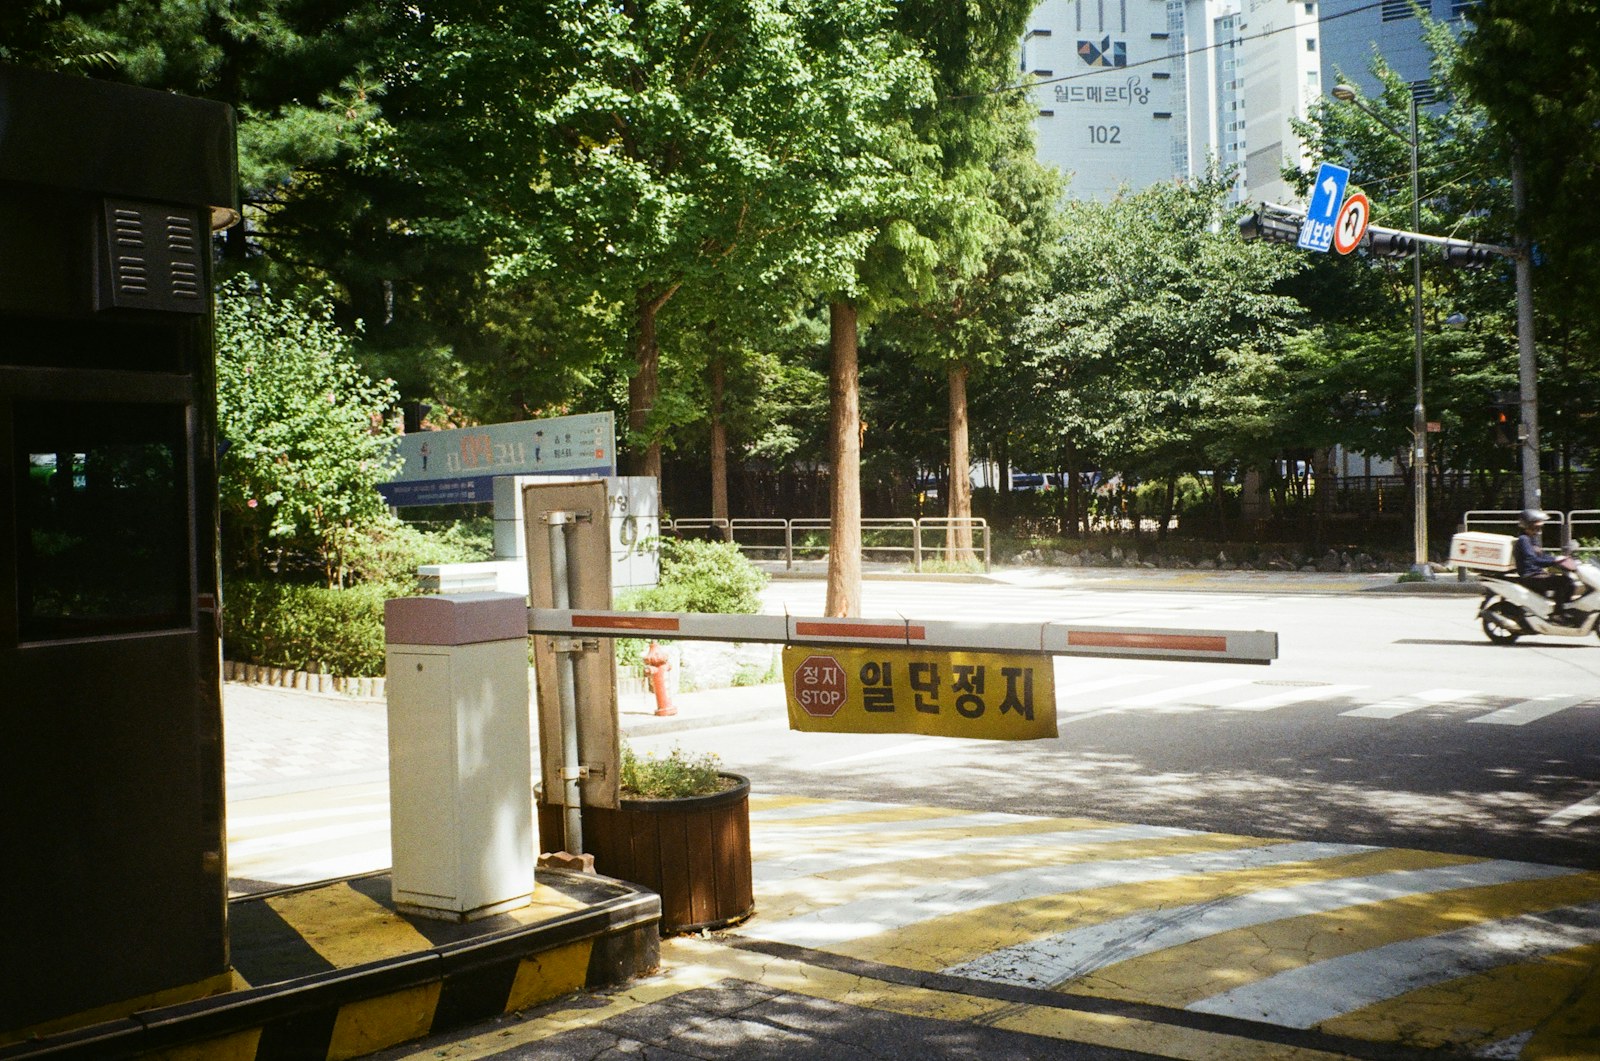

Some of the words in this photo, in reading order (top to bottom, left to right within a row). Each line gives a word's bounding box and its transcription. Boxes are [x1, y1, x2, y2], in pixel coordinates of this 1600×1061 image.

[1054, 75, 1151, 106] 월드메르디앙
[1088, 125, 1121, 144] 102
[1301, 219, 1333, 247] 비보호
[803, 666, 837, 686] 정지
[801, 690, 840, 705] STOP
[859, 661, 1035, 721] 일단정지
